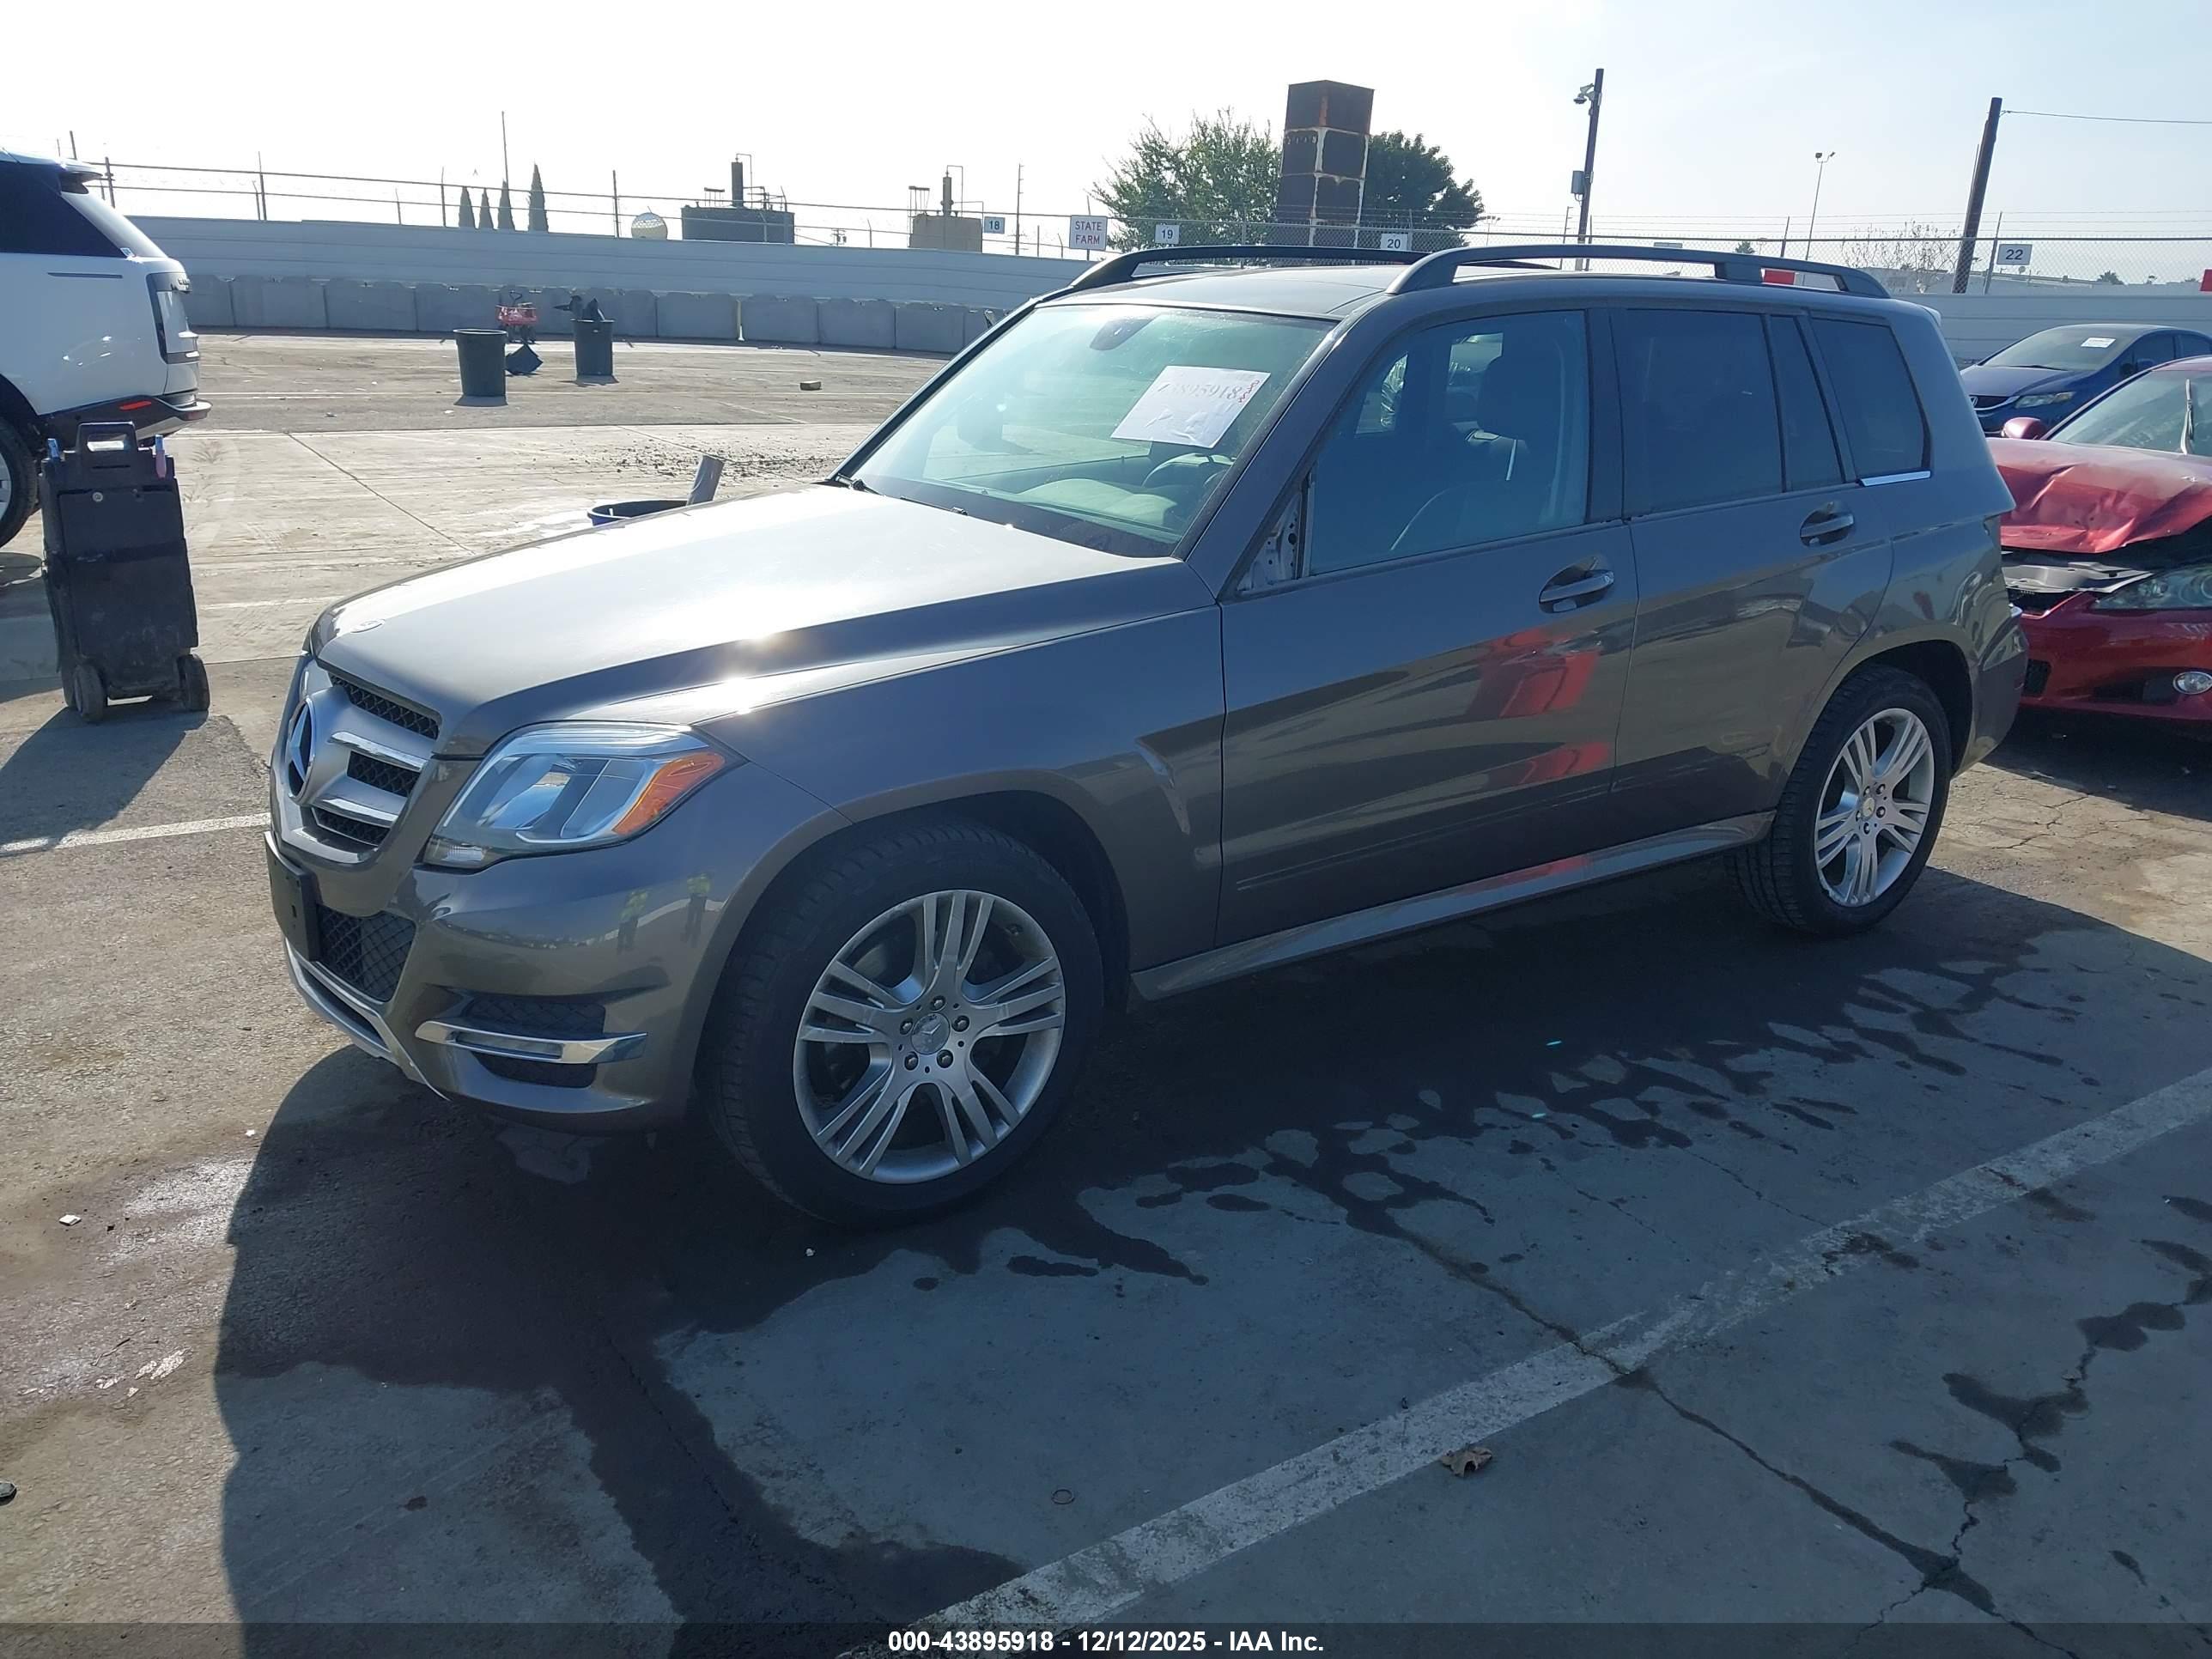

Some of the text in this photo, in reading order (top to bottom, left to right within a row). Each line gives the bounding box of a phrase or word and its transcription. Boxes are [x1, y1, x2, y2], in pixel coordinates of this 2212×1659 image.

[989, 220, 1000, 230] 18
[1075, 221, 1102, 231] STATE
[1162, 228, 1173, 240] 19
[1075, 234, 1100, 245] FARM
[1387, 239, 1401, 249] 20
[2005, 249, 2023, 260] 22
